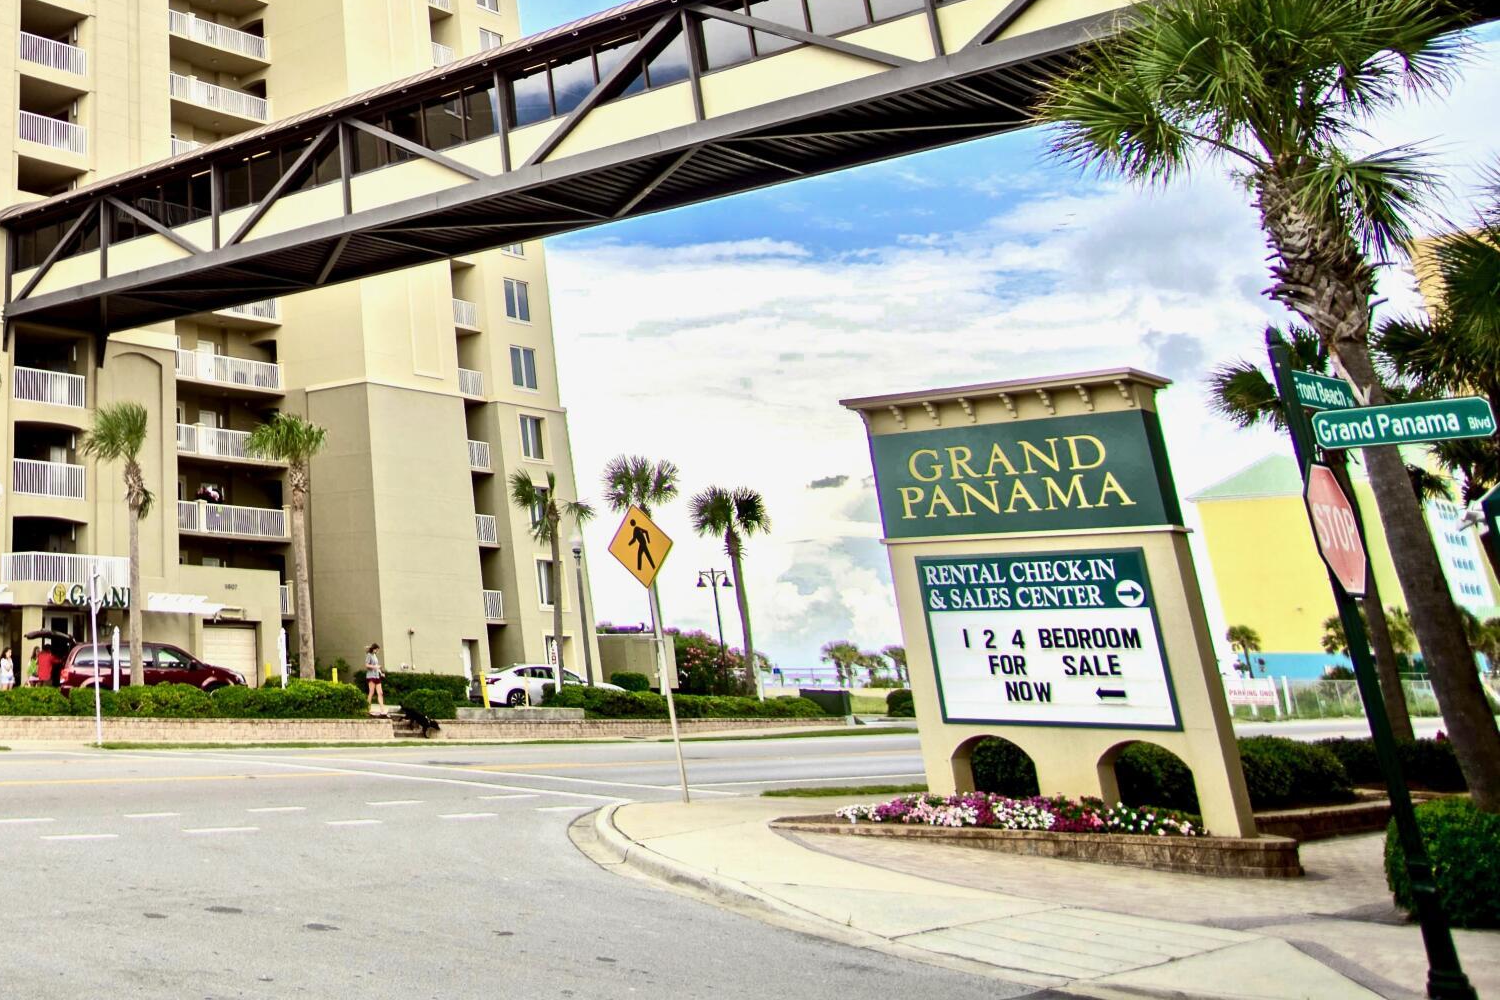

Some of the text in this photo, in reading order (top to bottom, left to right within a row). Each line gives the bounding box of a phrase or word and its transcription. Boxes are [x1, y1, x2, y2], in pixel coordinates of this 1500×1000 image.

[1316, 381, 1346, 407] Beach
[1317, 411, 1491, 442] Grand Panama Blvd
[908, 434, 1107, 482] GRAND
[897, 471, 1137, 519] PANAMA
[1312, 502, 1357, 553] STOP
[923, 558, 1117, 586] RENTAL CHECK-IN
[70, 584, 131, 608] GAN
[929, 585, 1105, 609] & SALES CENTER
[983, 629, 997, 649] 2
[1011, 629, 1025, 649] 4
[1038, 628, 1142, 649] BEDROOM
[988, 654, 1122, 676] FOR SALE
[1005, 681, 1051, 702] NOW
